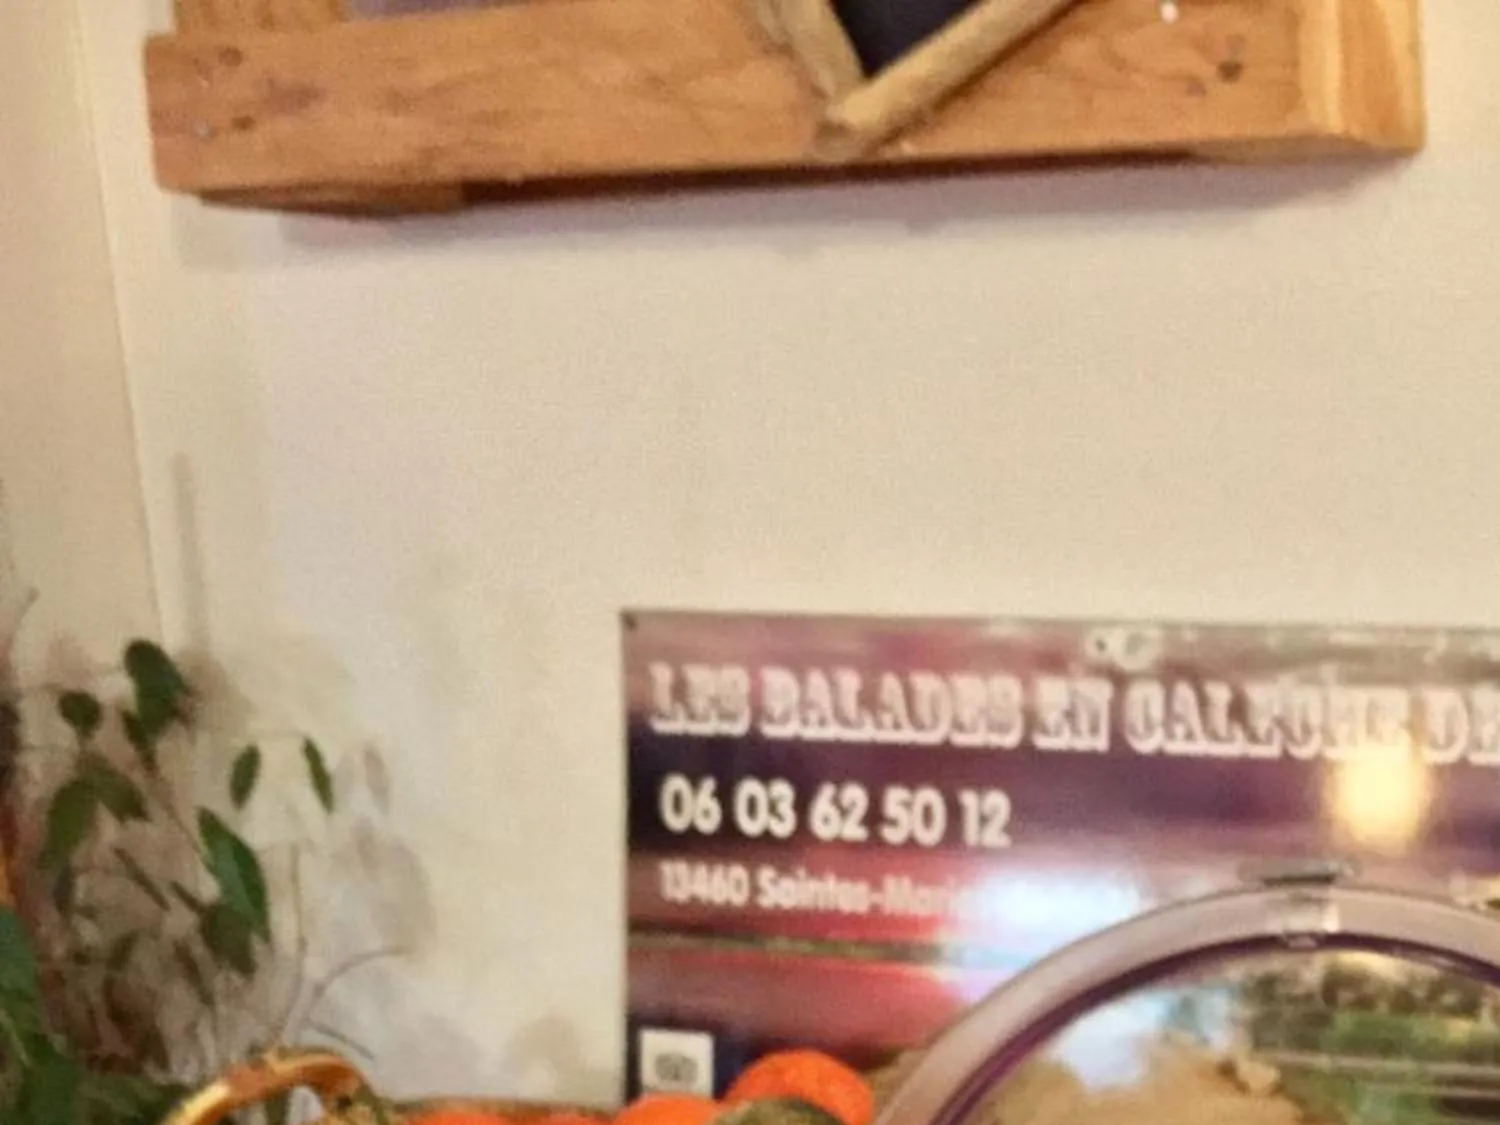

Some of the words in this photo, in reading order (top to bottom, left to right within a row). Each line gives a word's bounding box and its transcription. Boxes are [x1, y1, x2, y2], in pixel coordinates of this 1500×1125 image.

[660, 774, 722, 834] 06
[734, 777, 796, 838] 03
[809, 781, 870, 842] 62
[881, 784, 947, 847] 50
[958, 789, 1013, 848] 12
[660, 859, 751, 905] 13460
